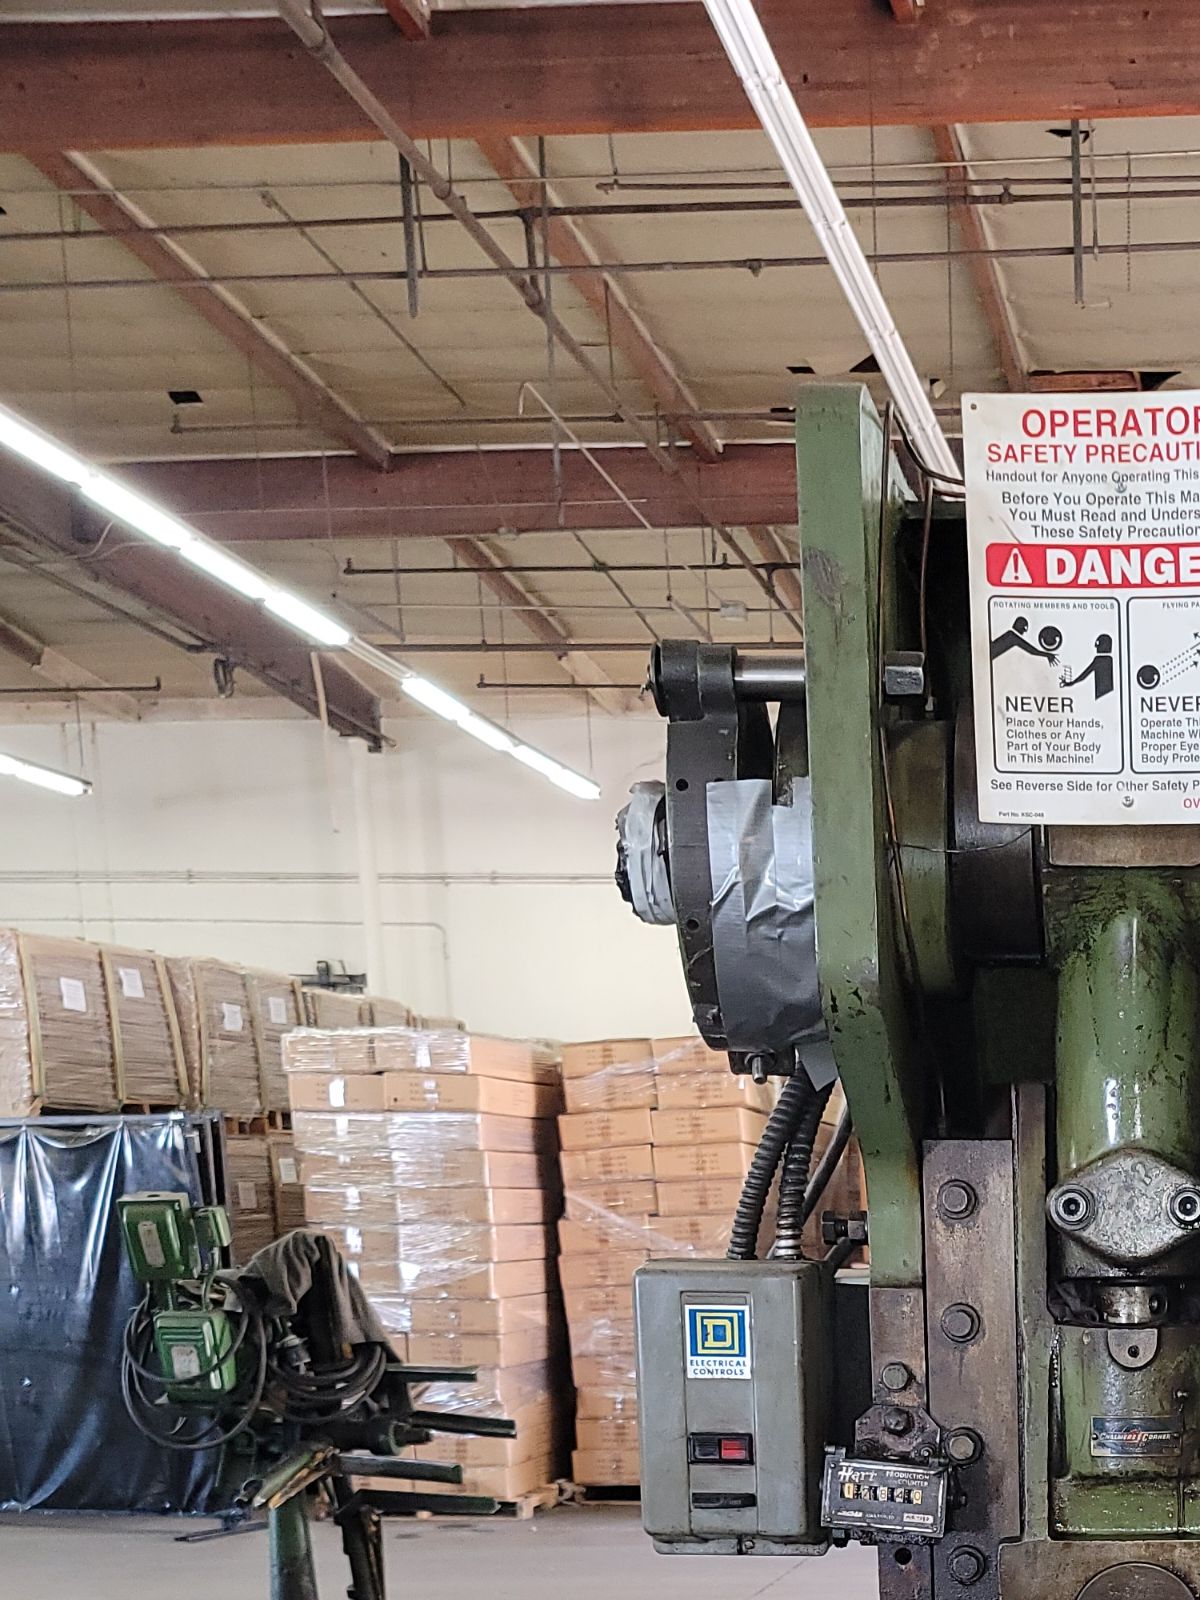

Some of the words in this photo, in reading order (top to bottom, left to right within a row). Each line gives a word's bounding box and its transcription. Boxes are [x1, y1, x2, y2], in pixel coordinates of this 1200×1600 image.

[987, 443, 1078, 464] SAFETY
[986, 470, 1037, 483] Handout
[1041, 471, 1058, 483] for
[1062, 470, 1108, 486] Anyone
[1111, 470, 1170, 484] Operating
[1174, 468, 1200, 481] This
[1002, 491, 1049, 505] Before
[1053, 492, 1081, 506] You
[1085, 492, 1141, 508] Operate
[1146, 491, 1176, 504] This
[1009, 507, 1037, 522] You
[1041, 508, 1076, 523] Must
[1080, 508, 1116, 523] Read
[1120, 508, 1147, 522] and
[1031, 524, 1075, 539] These
[1078, 524, 1123, 541] Safety
[1072, 602, 1088, 610] AND
[1162, 601, 1189, 609] FLYING
[1005, 696, 1074, 713] NEVER
[1006, 717, 1035, 728] Place
[1038, 718, 1064, 729] Your
[1066, 718, 1104, 729] Hands,
[1140, 718, 1182, 730] Operate
[1006, 729, 1047, 740] Clothes
[1050, 731, 1062, 740] or
[1064, 730, 1086, 742] Any
[1140, 730, 1185, 740] Machine
[1007, 741, 1029, 752] Part
[1031, 742, 1042, 752] of
[1045, 742, 1070, 752] Your
[1073, 742, 1102, 755] Body
[1141, 741, 1177, 754] Proper
[1180, 741, 1200, 753] Eye
[1020, 753, 1043, 764] This
[1046, 754, 1094, 764] Machine!
[1141, 754, 1169, 765] Body
[990, 779, 1013, 791] See
[1016, 780, 1064, 791] Reverse
[1066, 780, 1093, 792] Side
[1096, 780, 1113, 792] for
[1115, 780, 1149, 792] Other
[1152, 779, 1189, 793] Safety
[703, 1319, 732, 1347] D
[693, 1368, 745, 1376] CONTROLS
[838, 1466, 877, 1483] Hart
[886, 1471, 930, 1480] PRODUCTION
[898, 1479, 928, 1487] COUNTER
